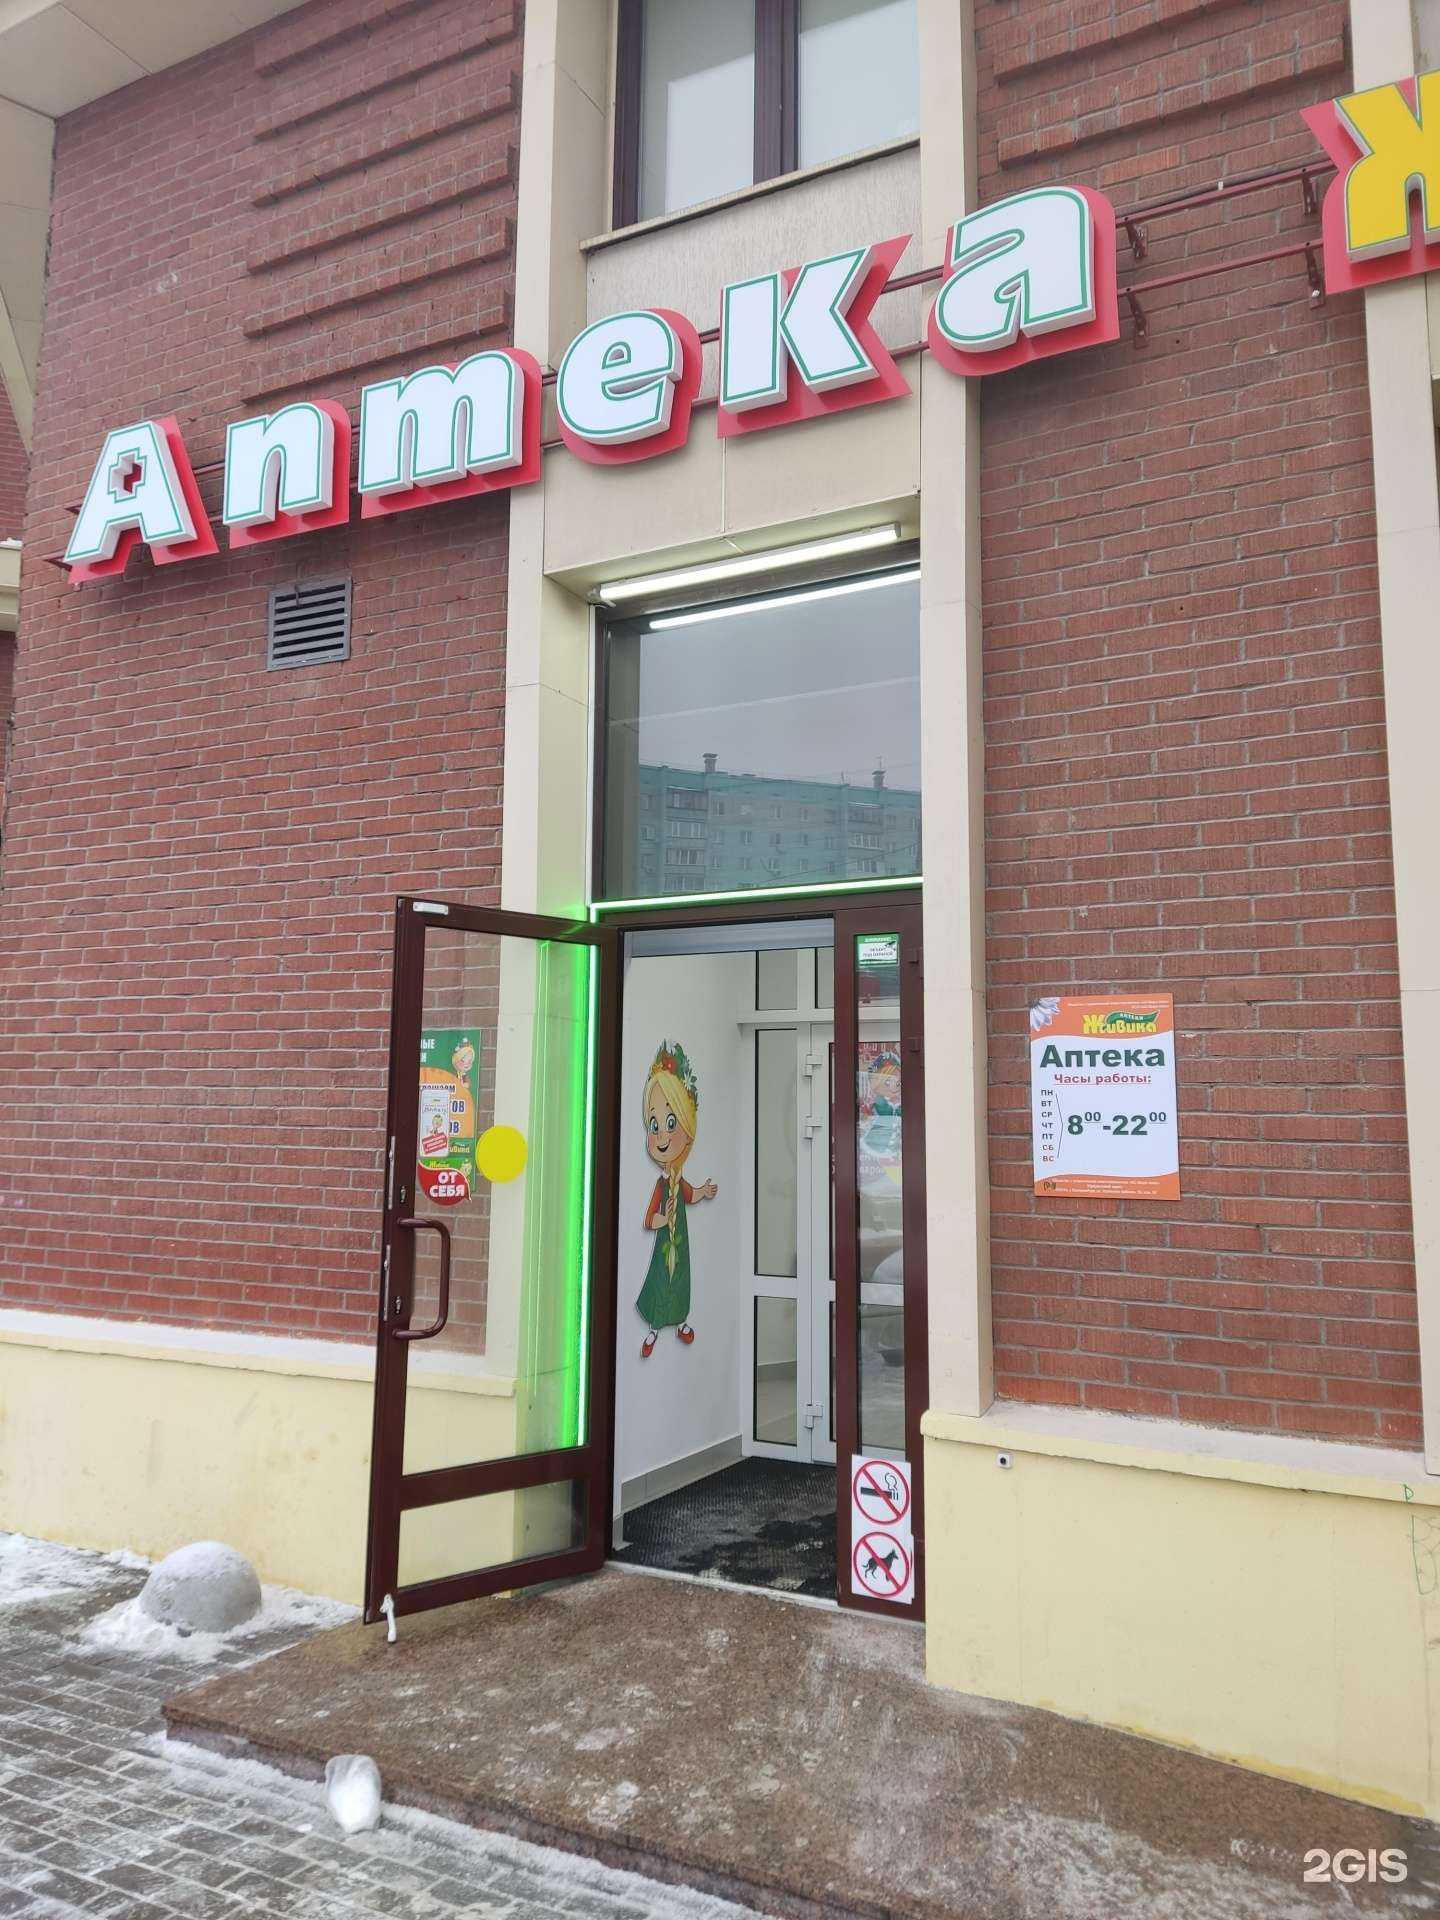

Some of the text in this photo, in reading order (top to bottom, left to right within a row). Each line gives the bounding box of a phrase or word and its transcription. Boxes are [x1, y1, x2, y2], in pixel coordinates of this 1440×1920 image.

[64, 187, 1100, 570] Аптека
[421, 1039, 435, 1050] ЫЕ
[1040, 1045, 1165, 1068] Аптека
[1054, 1074, 1152, 1085] Часы работы:
[438, 1171, 457, 1184] ОТ
[429, 1184, 465, 1197] СЕБЯ
